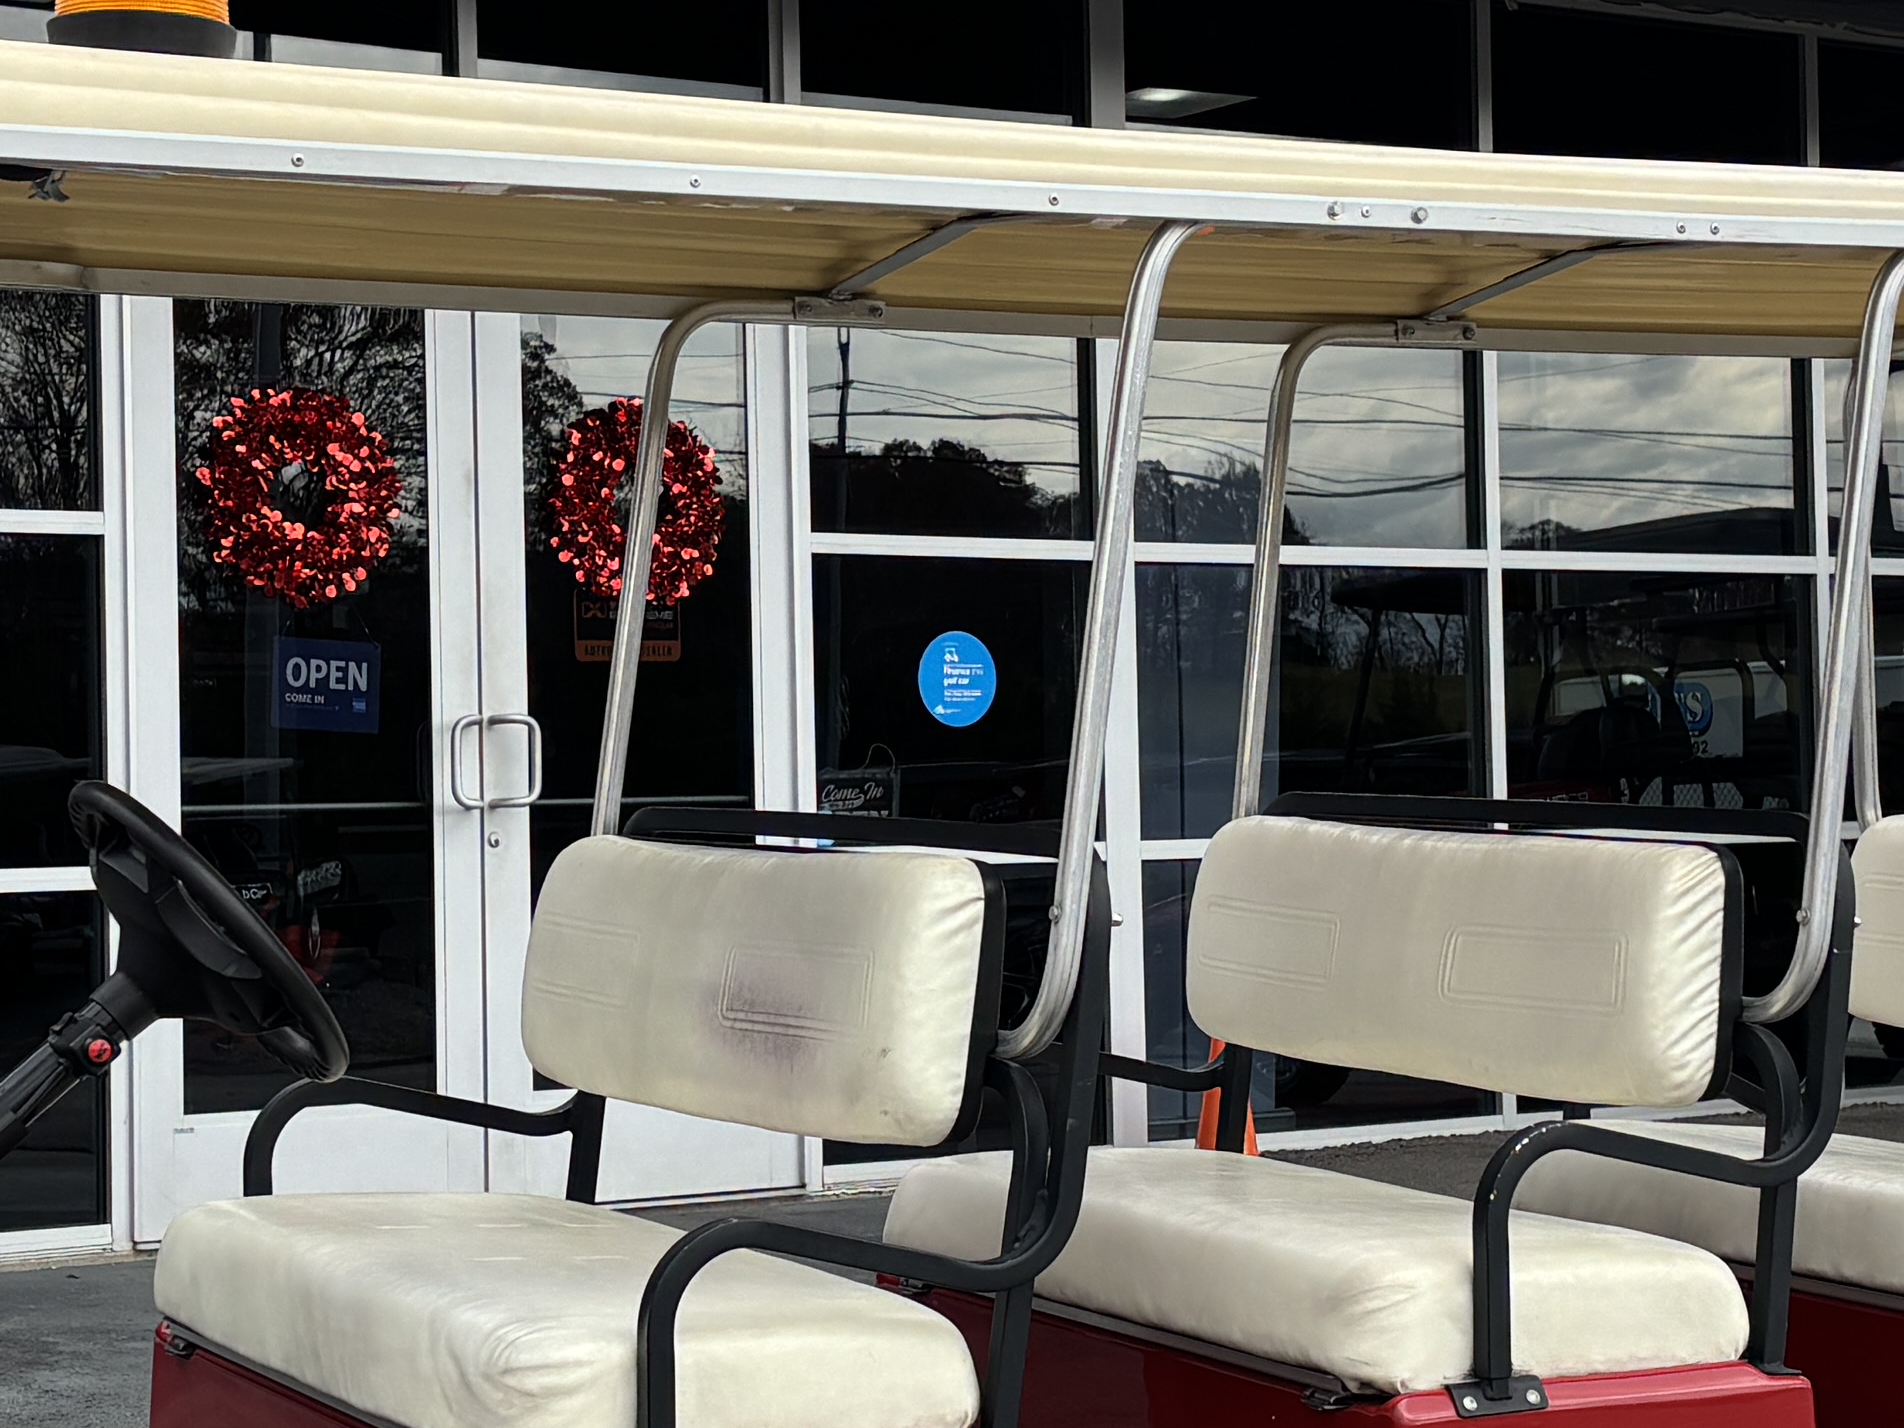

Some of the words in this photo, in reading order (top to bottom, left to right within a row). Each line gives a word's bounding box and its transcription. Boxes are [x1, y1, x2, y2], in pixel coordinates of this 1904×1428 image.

[285, 656, 368, 692] OPEN
[284, 692, 313, 704] COME
[314, 694, 325, 704] IN
